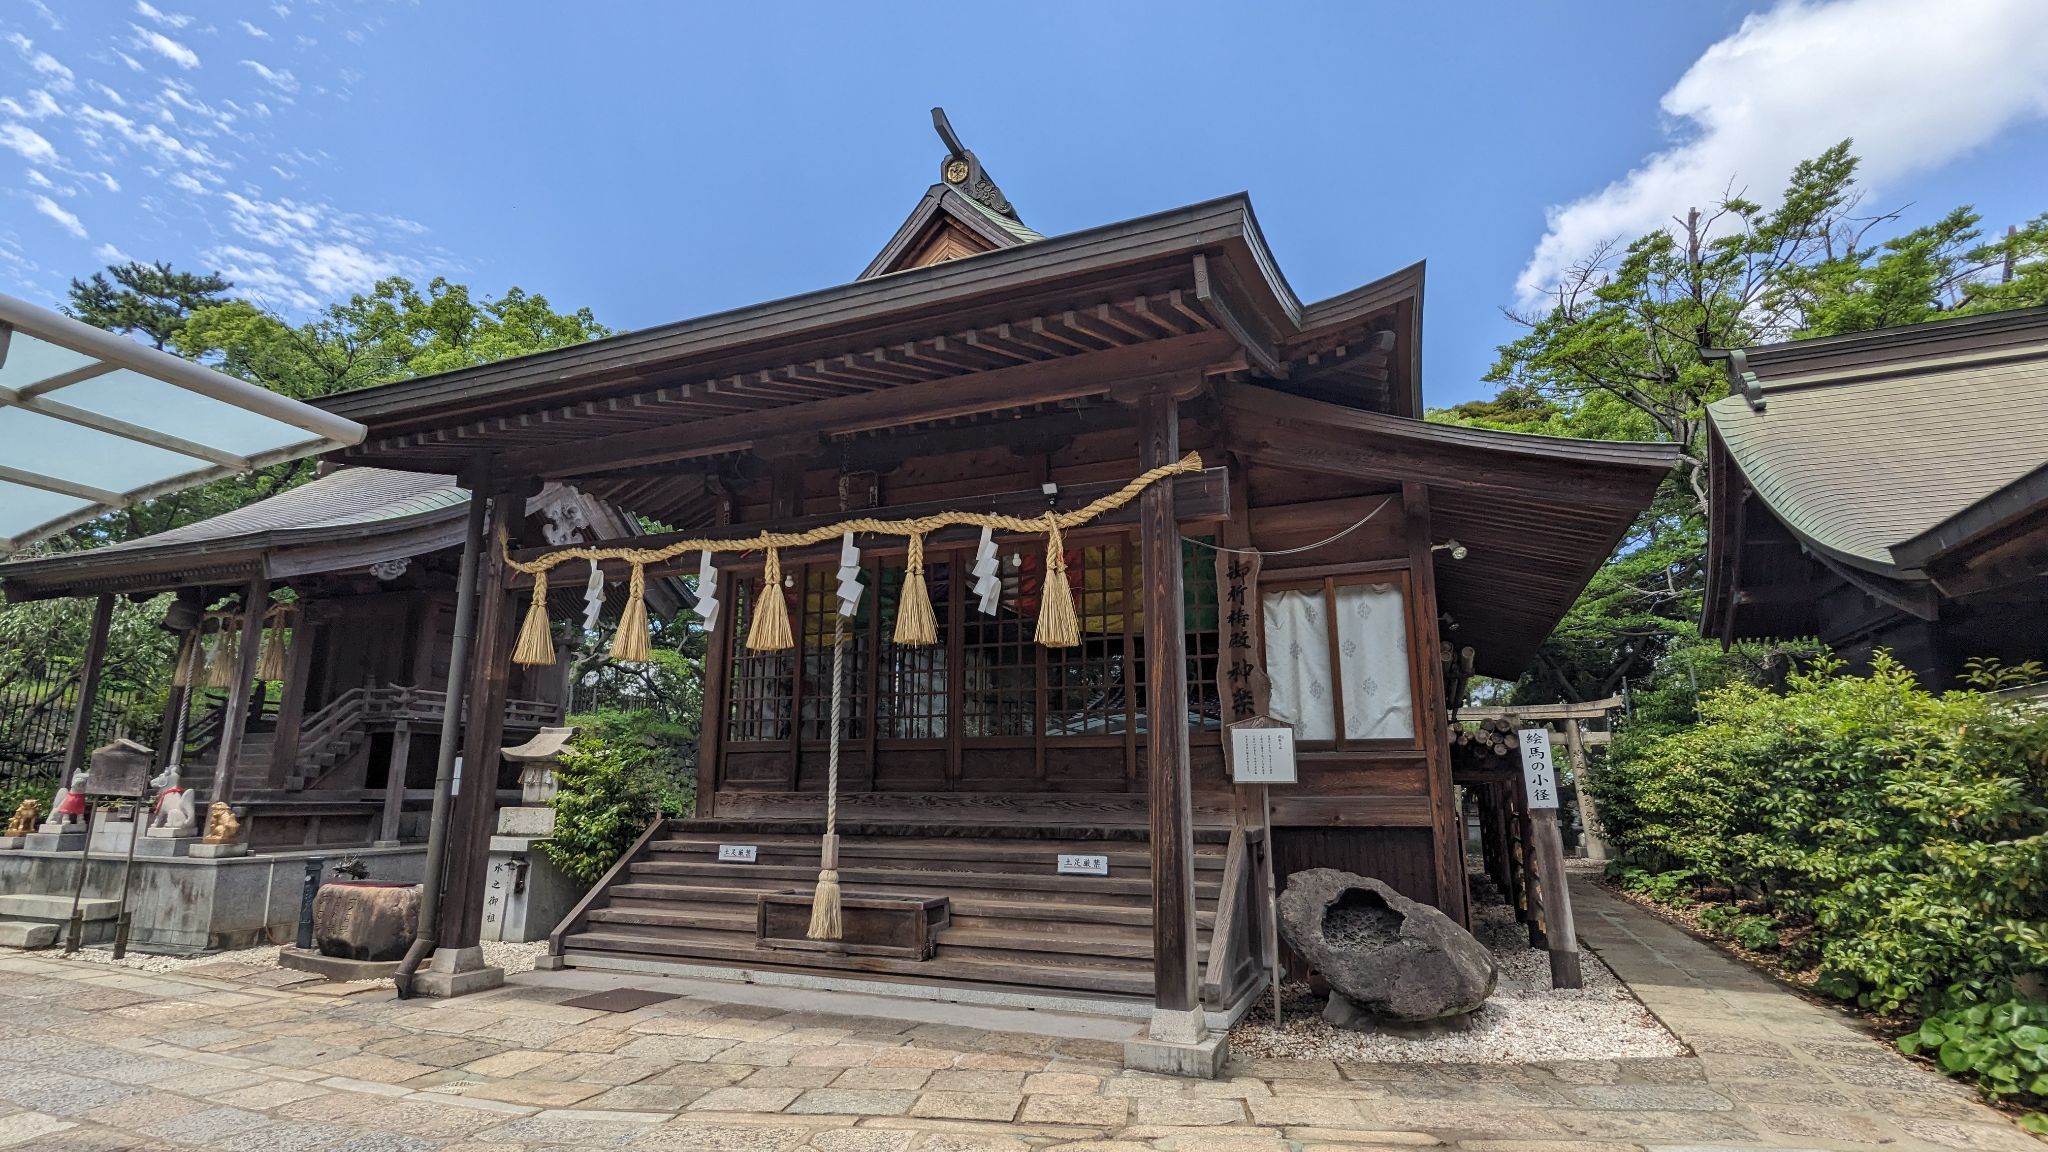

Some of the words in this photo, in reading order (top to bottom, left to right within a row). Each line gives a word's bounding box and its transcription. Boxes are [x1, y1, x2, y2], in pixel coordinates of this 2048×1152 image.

[1526, 732, 1550, 801] 絵馬の小径
[1064, 857, 1101, 868] 土足厳禁
